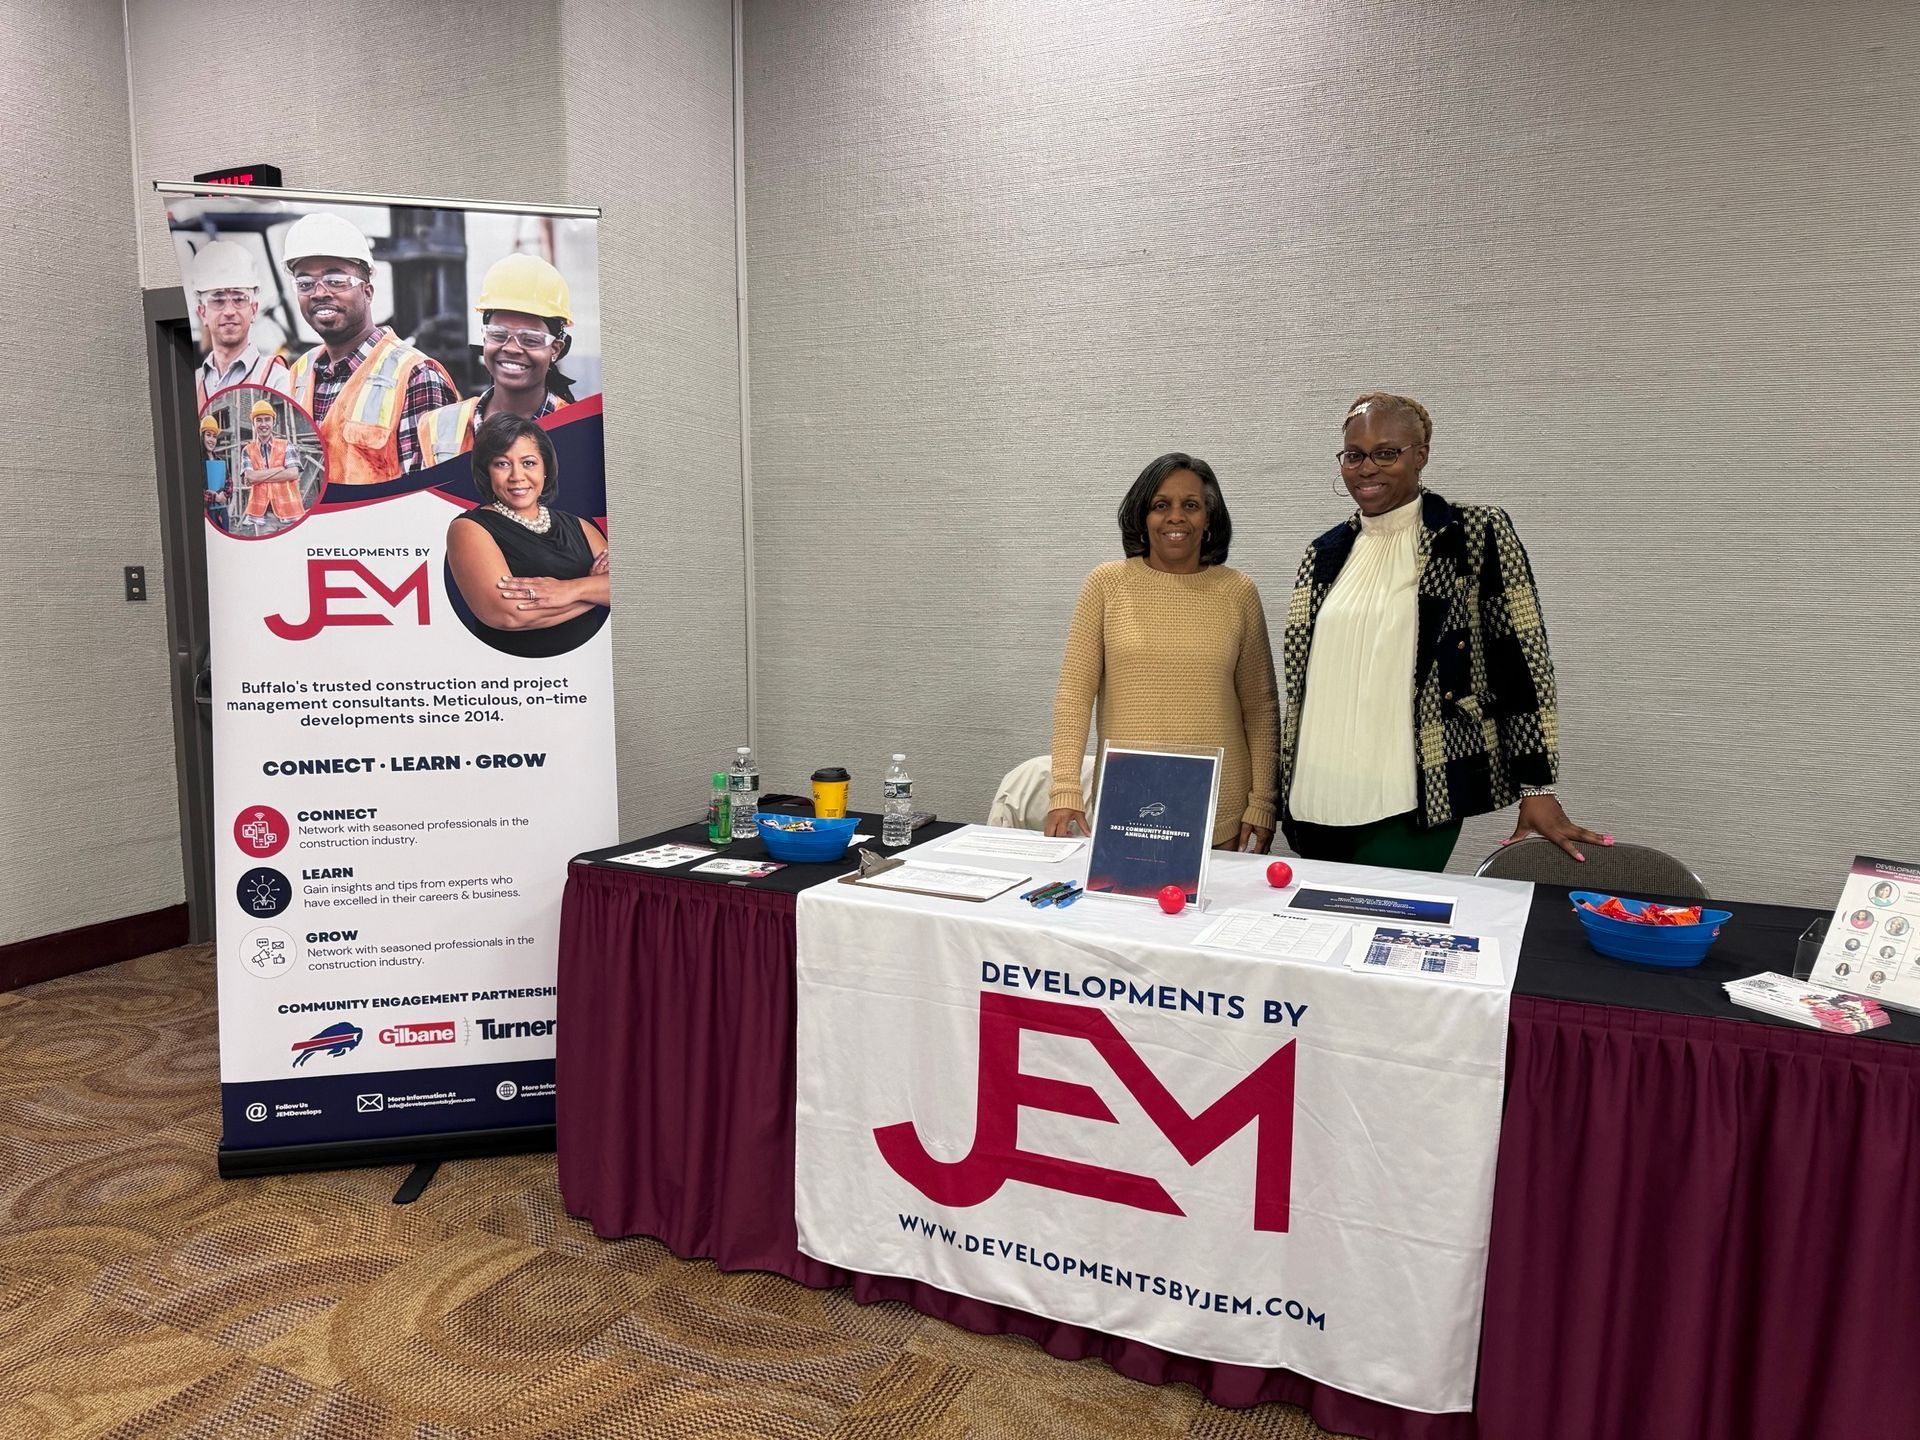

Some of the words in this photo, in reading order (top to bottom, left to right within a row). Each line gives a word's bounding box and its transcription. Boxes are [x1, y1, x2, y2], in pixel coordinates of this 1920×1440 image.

[307, 547, 409, 557] DEVELOPMENTS
[415, 547, 430, 557] BY
[264, 560, 430, 641] JEM
[242, 681, 308, 693] Buffalo's
[313, 679, 371, 692] trusted
[376, 677, 476, 691] construction
[481, 677, 508, 689] and
[513, 676, 568, 690] project
[227, 696, 328, 713] management
[333, 695, 429, 709] consultants.
[433, 693, 522, 707] Meticulous,
[526, 692, 587, 705] on-time
[301, 712, 414, 727] developments
[419, 712, 460, 723] since
[464, 710, 504, 723] 2014.
[263, 757, 376, 776] CONNECT
[391, 755, 461, 772] LEARN
[475, 752, 546, 769] GROW
[298, 808, 377, 822] CONNECT
[299, 823, 344, 834] Network
[348, 822, 370, 833] with
[373, 821, 424, 832] seasoned
[428, 818, 497, 831] professionals
[500, 818, 508, 826] in
[510, 817, 529, 826] the
[300, 837, 369, 848] construction
[372, 835, 418, 847] industry.
[302, 868, 353, 880] LEARN
[303, 884, 328, 894] Gain
[331, 881, 372, 895] insights
[375, 880, 394, 891] and
[397, 880, 418, 892] tips
[420, 878, 445, 888] from
[448, 877, 488, 890] experts
[491, 875, 513, 885] who
[304, 897, 330, 908] have
[333, 895, 377, 906] excelled
[380, 894, 389, 903] in
[392, 893, 416, 903] their
[419, 892, 459, 902] careers
[461, 890, 469, 900] &
[472, 888, 521, 899] business.
[306, 930, 358, 943] GROW
[308, 946, 352, 957] Network
[355, 945, 378, 955] with
[382, 942, 432, 954] seasoned
[435, 938, 503, 952] professionals
[506, 937, 514, 946] in
[517, 935, 535, 945] the
[308, 957, 377, 970] construction
[379, 956, 424, 968] industry.
[278, 999, 369, 1014] COMMUNITY
[372, 993, 469, 1008] ENGAGEMENT
[981, 961, 1245, 1019] DEVELOPMENTS
[1264, 1000, 1308, 1027] BY
[379, 1027, 454, 1045] Gilbane
[476, 1019, 556, 1040] Turner
[276, 1108, 322, 1117] JEMDevelops
[873, 991, 1297, 1233] JEM
[898, 1214, 1326, 1331] WWW.DEVELOPMENTSBYJEM.COM
